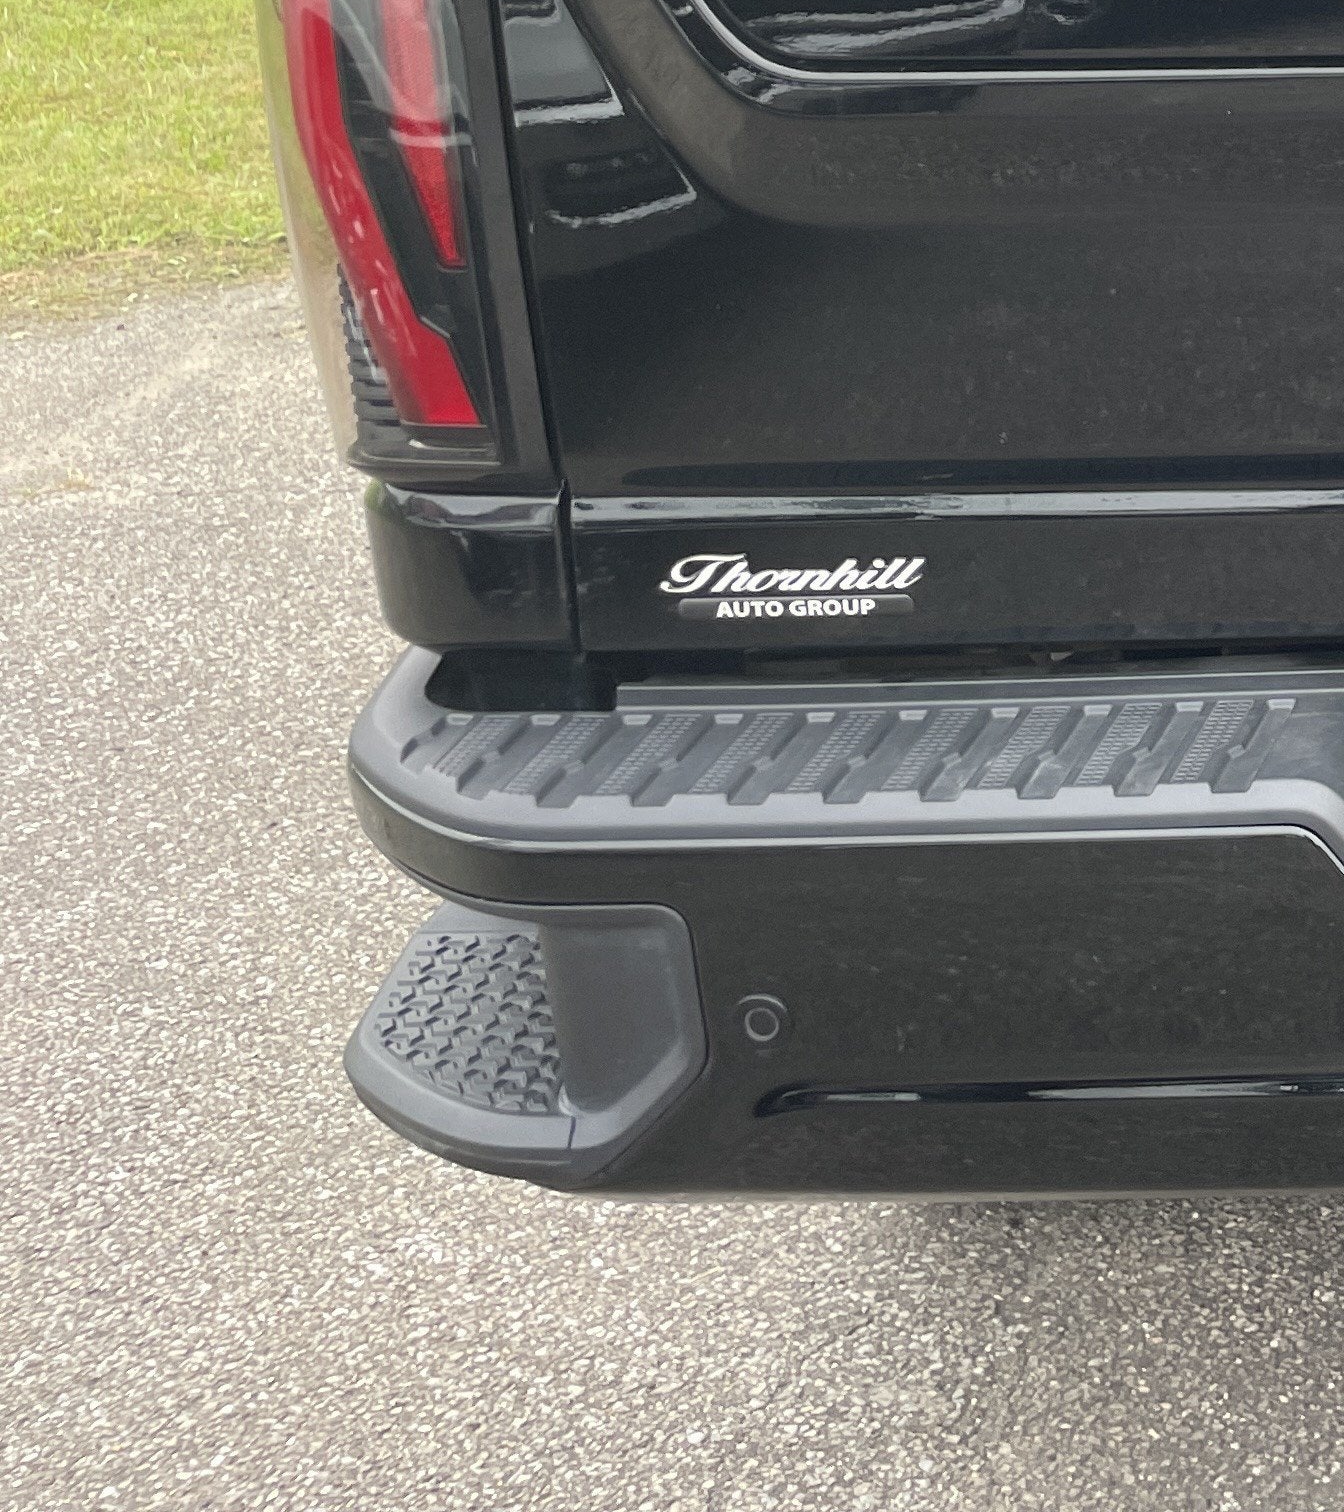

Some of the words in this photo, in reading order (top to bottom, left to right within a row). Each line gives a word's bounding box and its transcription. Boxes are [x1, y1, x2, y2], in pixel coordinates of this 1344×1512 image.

[659, 553, 927, 594] Thornhill
[716, 600, 784, 619] AUTO
[788, 598, 876, 618] GROUP
